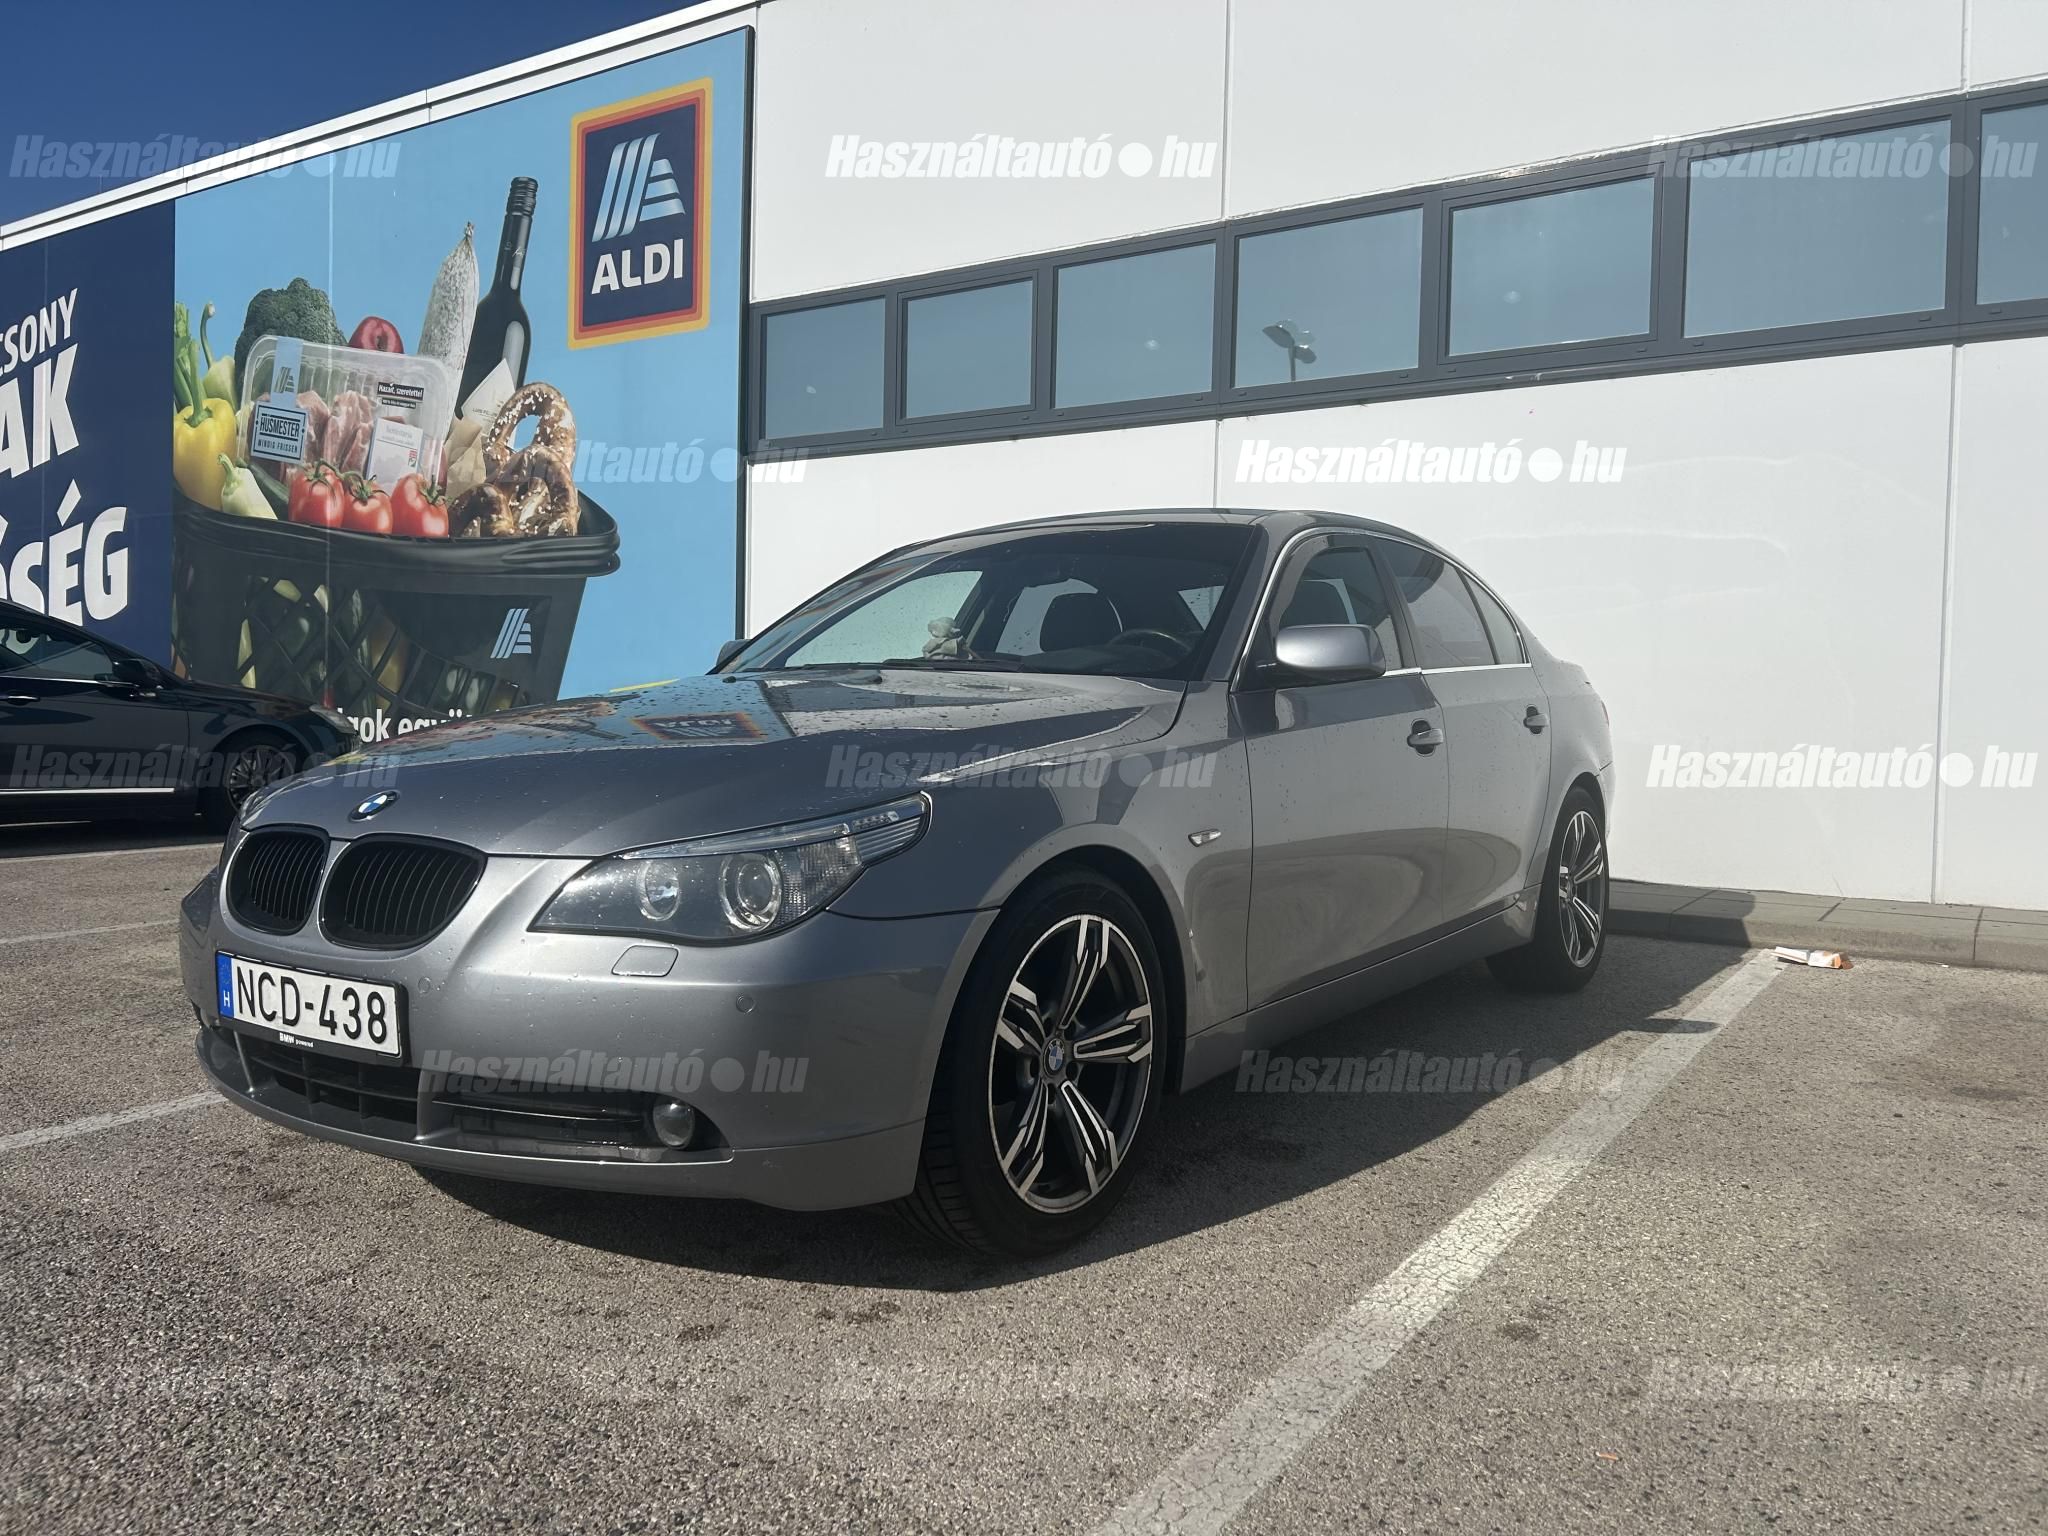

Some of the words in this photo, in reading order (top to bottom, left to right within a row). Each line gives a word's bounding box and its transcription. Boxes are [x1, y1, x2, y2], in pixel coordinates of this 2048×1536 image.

[592, 239, 683, 294] ALDI
[0, 478, 128, 626] SÉG
[223, 991, 231, 1008] H
[236, 966, 387, 1045] NCD-438
[279, 1032, 295, 1044] BMW
[295, 1039, 314, 1048] powered
